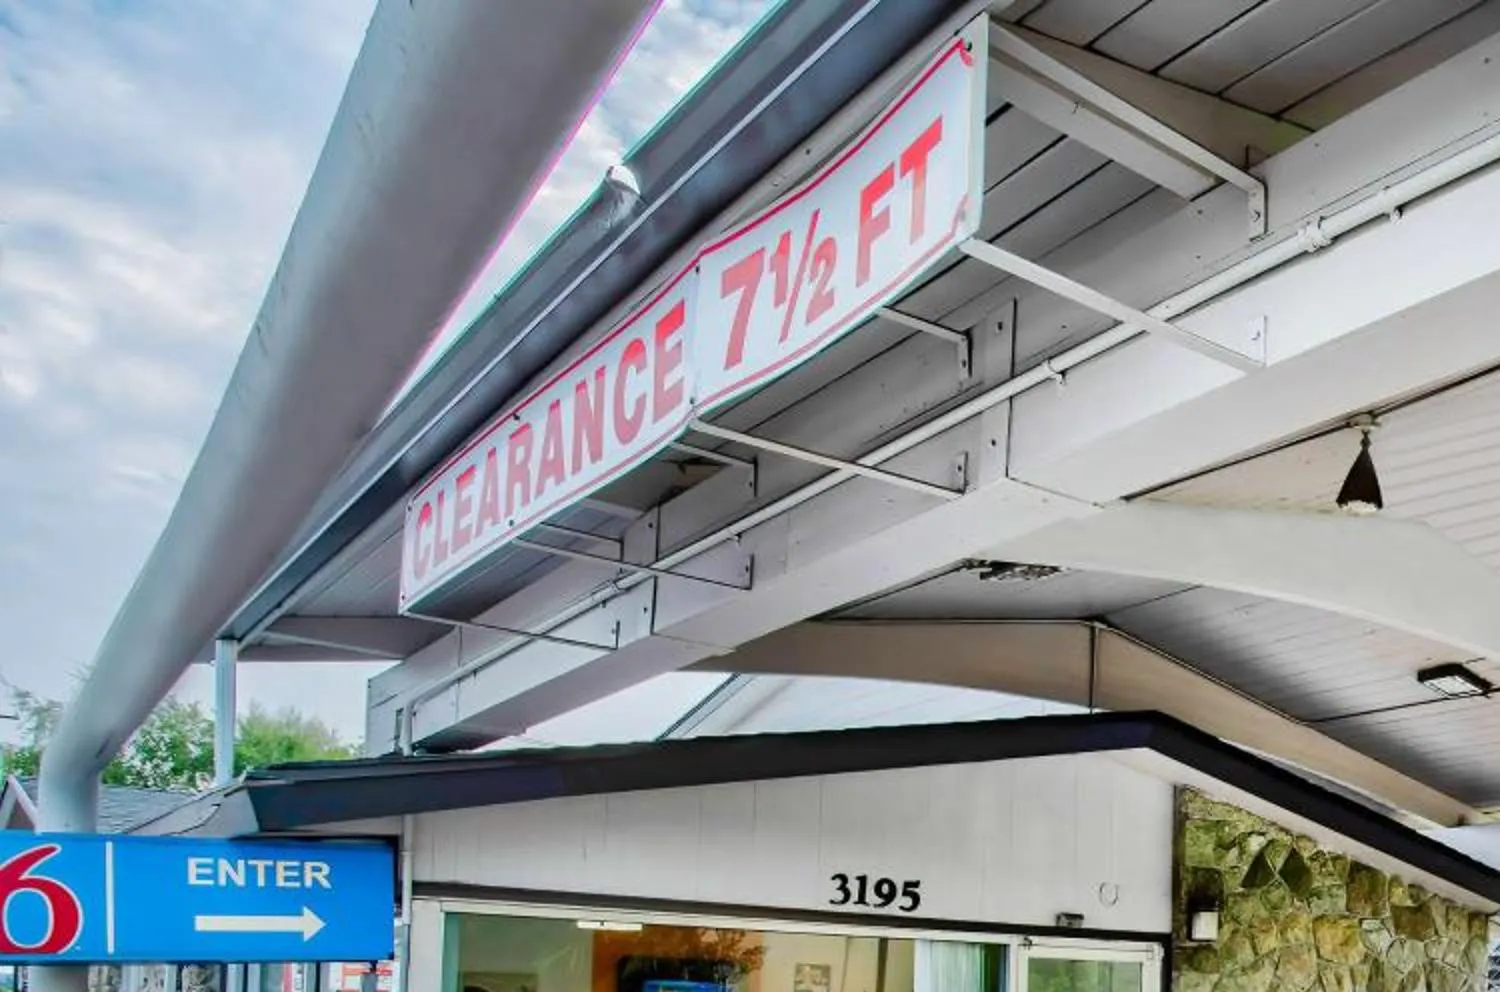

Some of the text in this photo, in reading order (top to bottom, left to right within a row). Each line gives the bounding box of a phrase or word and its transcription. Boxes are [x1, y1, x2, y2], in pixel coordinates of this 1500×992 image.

[413, 299, 685, 579] CLEARANCE
[855, 115, 943, 288] FT
[186, 856, 332, 889] ENTER
[829, 872, 921, 912] 3195
